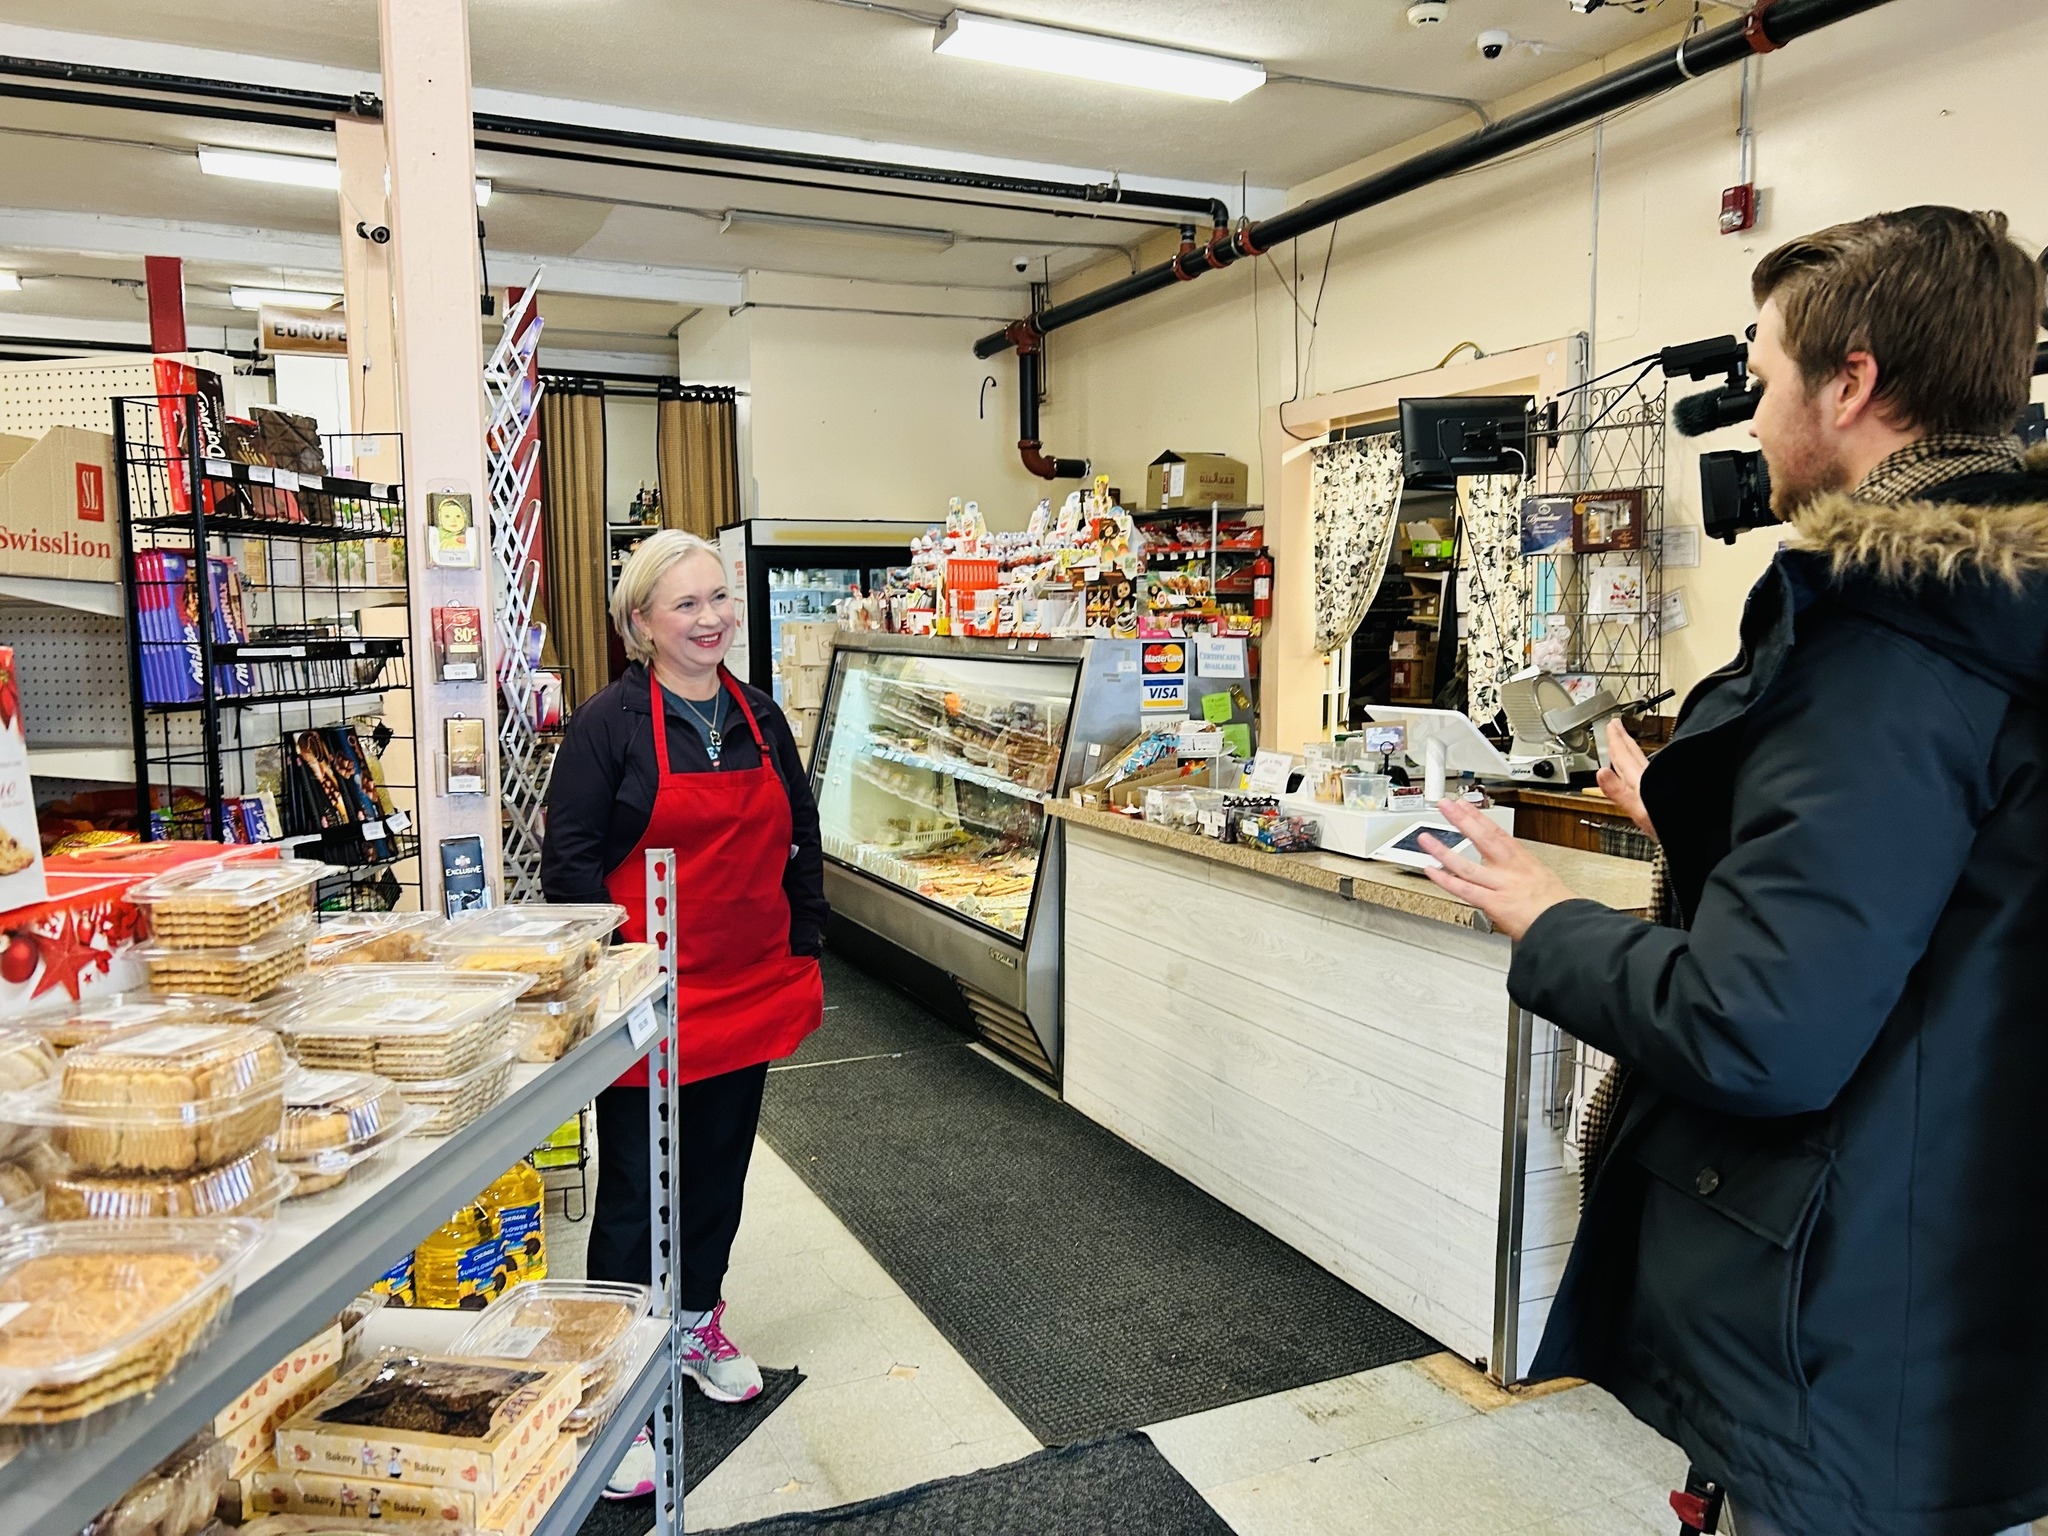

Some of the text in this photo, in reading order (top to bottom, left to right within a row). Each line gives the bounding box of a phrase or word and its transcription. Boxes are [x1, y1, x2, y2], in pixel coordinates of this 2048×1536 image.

[0, 525, 112, 559] Swisslion
[1144, 653, 1184, 664] MasterCard
[1149, 687, 1178, 699] VISA
[445, 865, 482, 877] EXCLUSIVE
[325, 1451, 446, 1476] Bakery Bakery
[303, 1493, 426, 1517] Bakery Bakery
